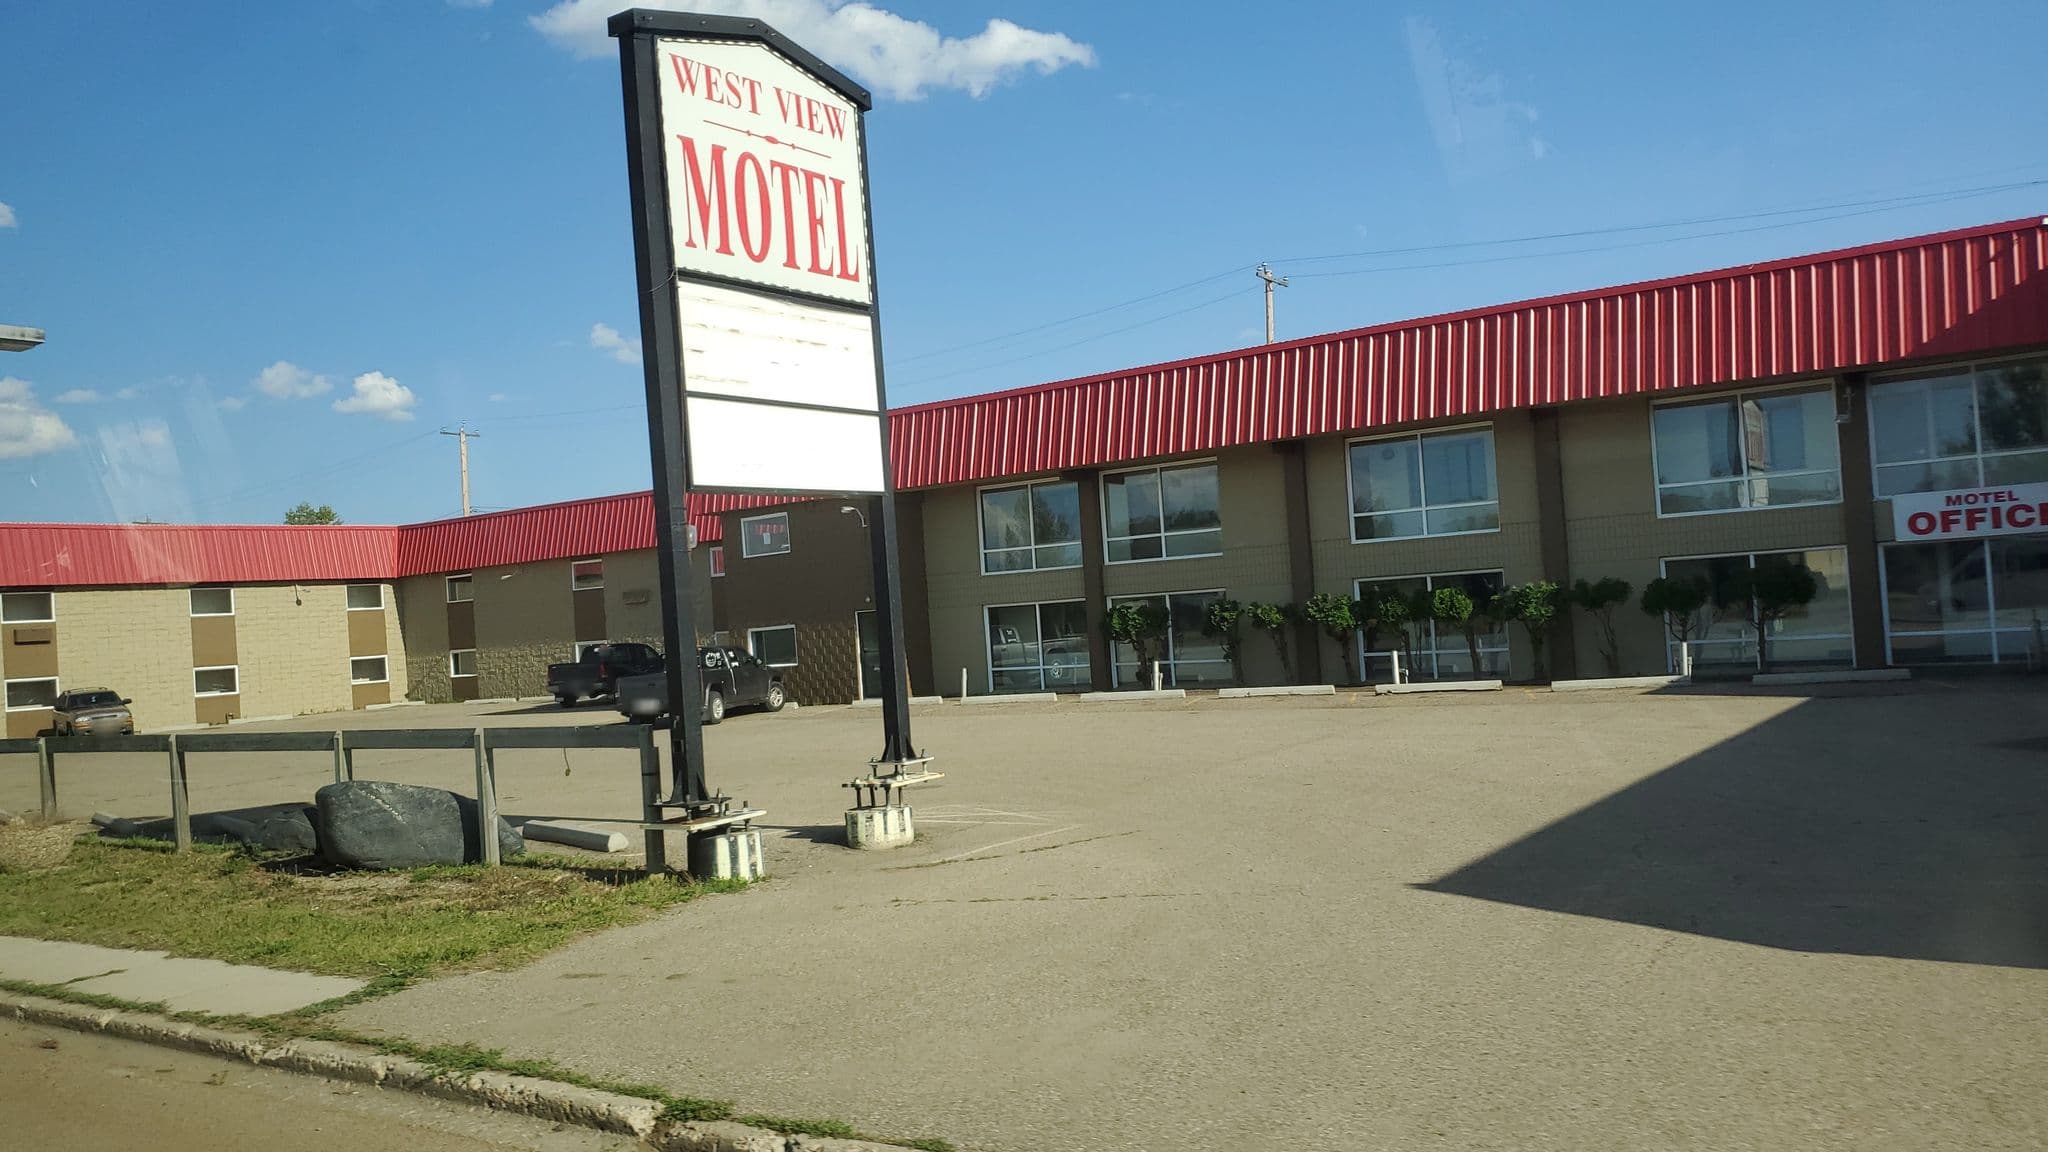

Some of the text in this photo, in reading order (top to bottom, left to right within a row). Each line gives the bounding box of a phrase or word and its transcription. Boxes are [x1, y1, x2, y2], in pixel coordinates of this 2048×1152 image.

[669, 53, 847, 142] WEST VIEW
[676, 134, 860, 283] MOTEL
[1945, 490, 2020, 507] MOTEL
